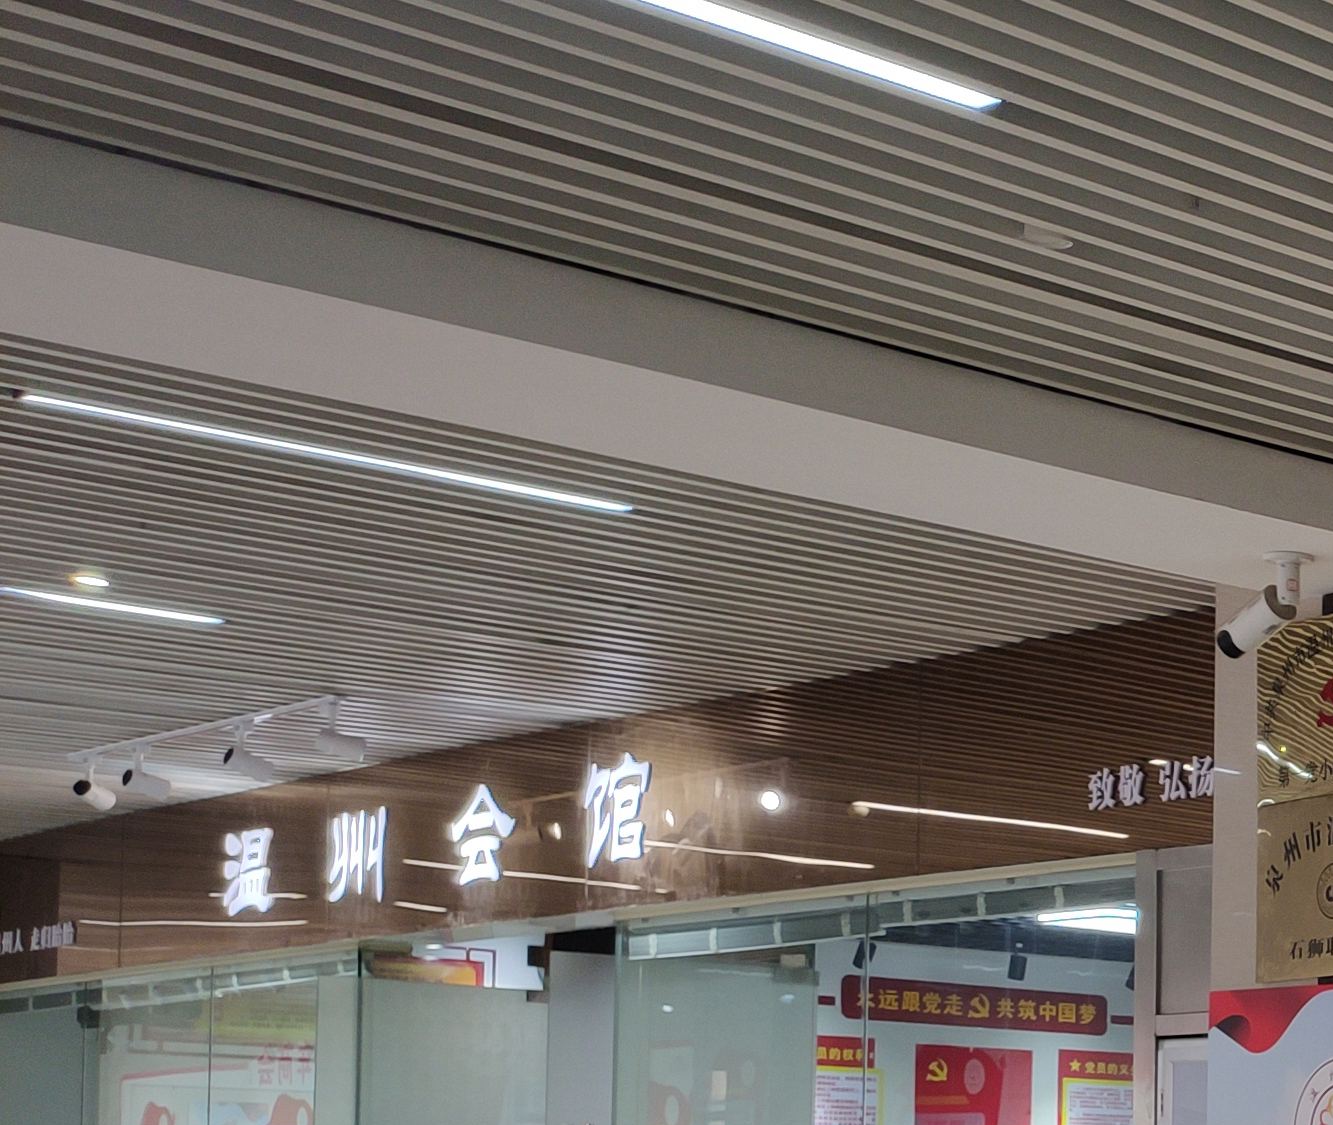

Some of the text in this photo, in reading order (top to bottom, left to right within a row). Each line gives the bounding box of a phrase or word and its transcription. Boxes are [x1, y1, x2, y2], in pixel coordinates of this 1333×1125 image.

[1088, 766, 1145, 811] 致敬
[223, 751, 652, 916] 温州会馆
[996, 998, 1097, 1025] 共筑中国梦
